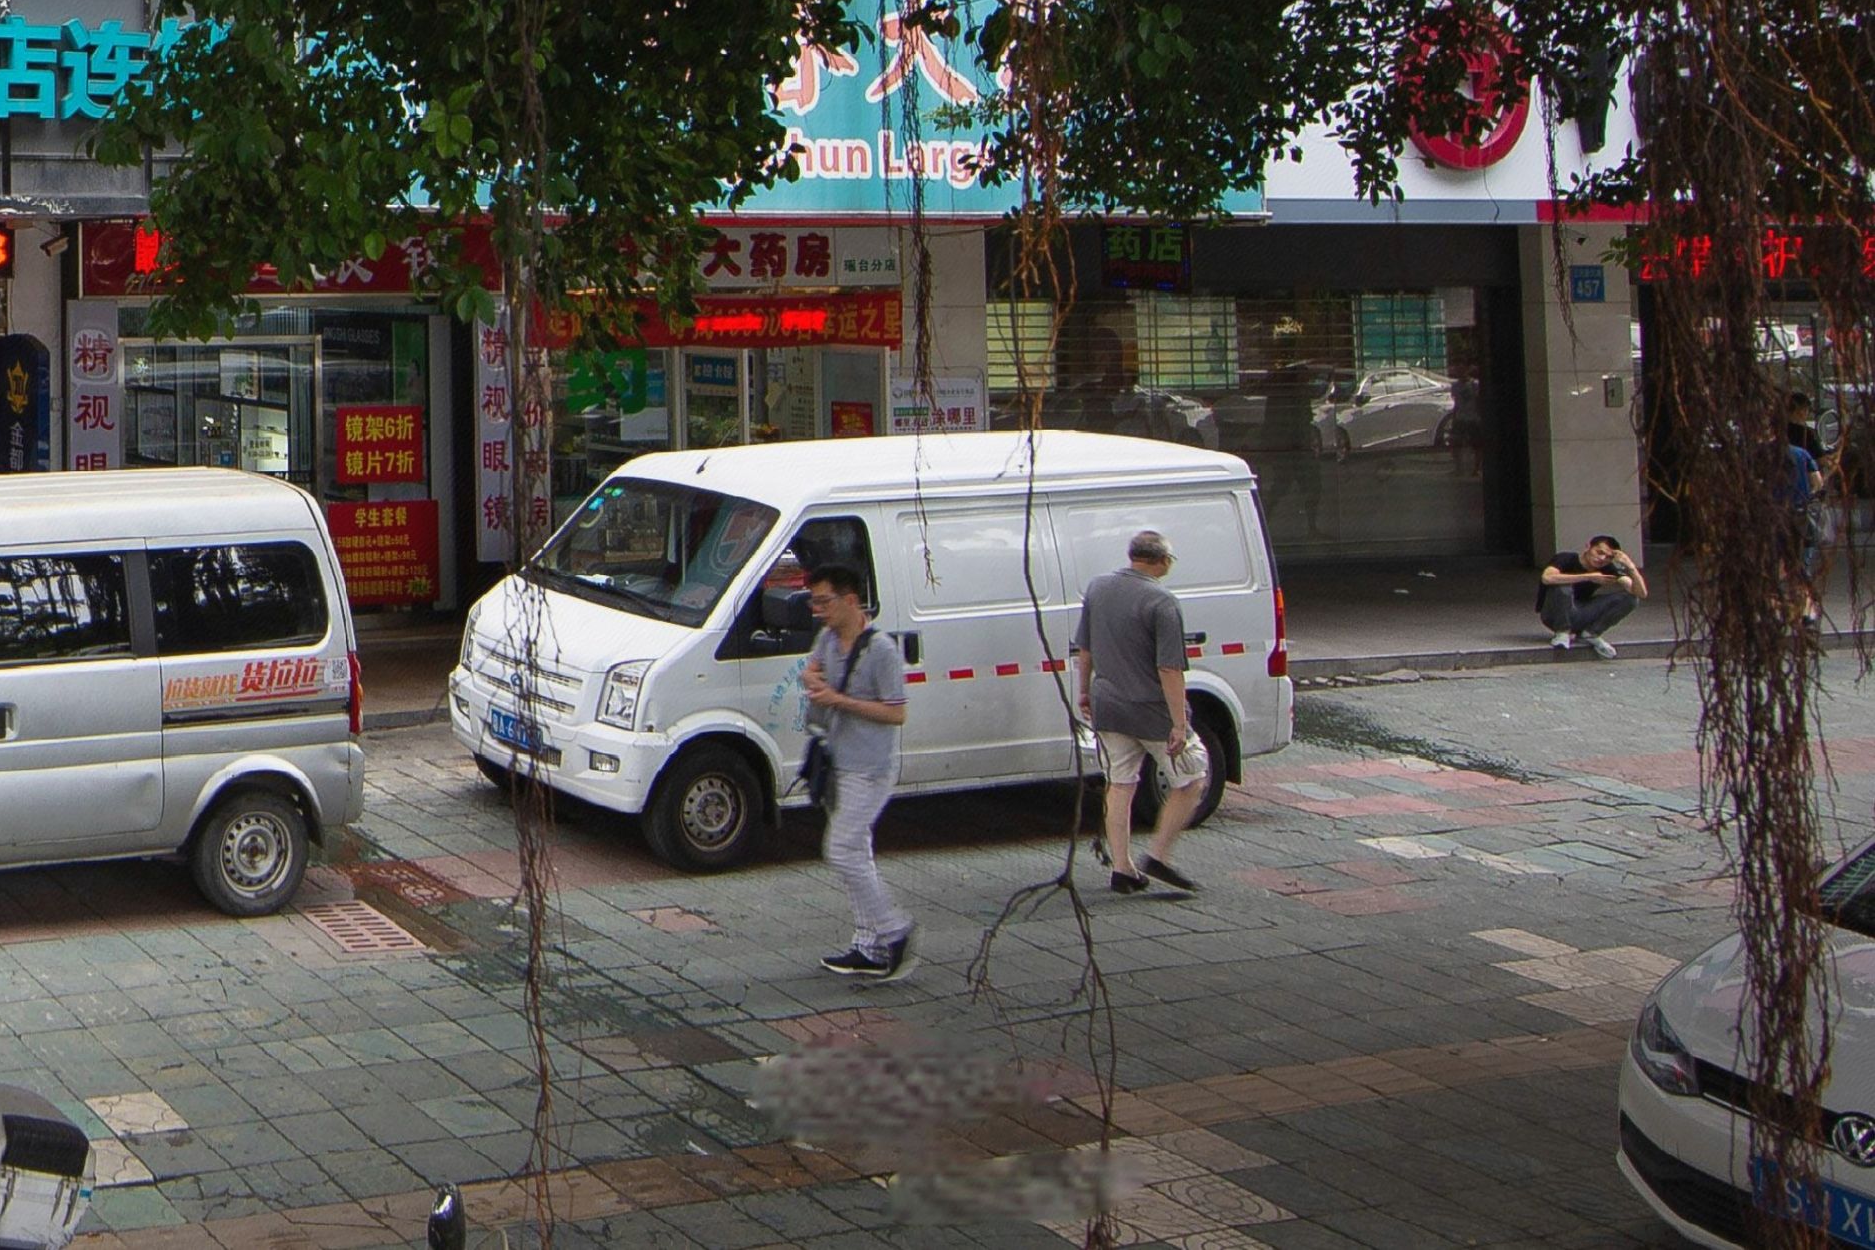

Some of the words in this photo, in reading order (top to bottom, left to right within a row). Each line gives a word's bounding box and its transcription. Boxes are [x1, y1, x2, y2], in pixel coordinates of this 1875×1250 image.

[759, 132, 869, 176] hun
[879, 130, 995, 183] Larg
[345, 414, 414, 441] 镜架6折
[482, 327, 511, 531] 精视眼镜
[345, 450, 414, 475] 镜片7折
[354, 507, 407, 528] 学生套餐
[239, 657, 319, 693] 货拉拉
